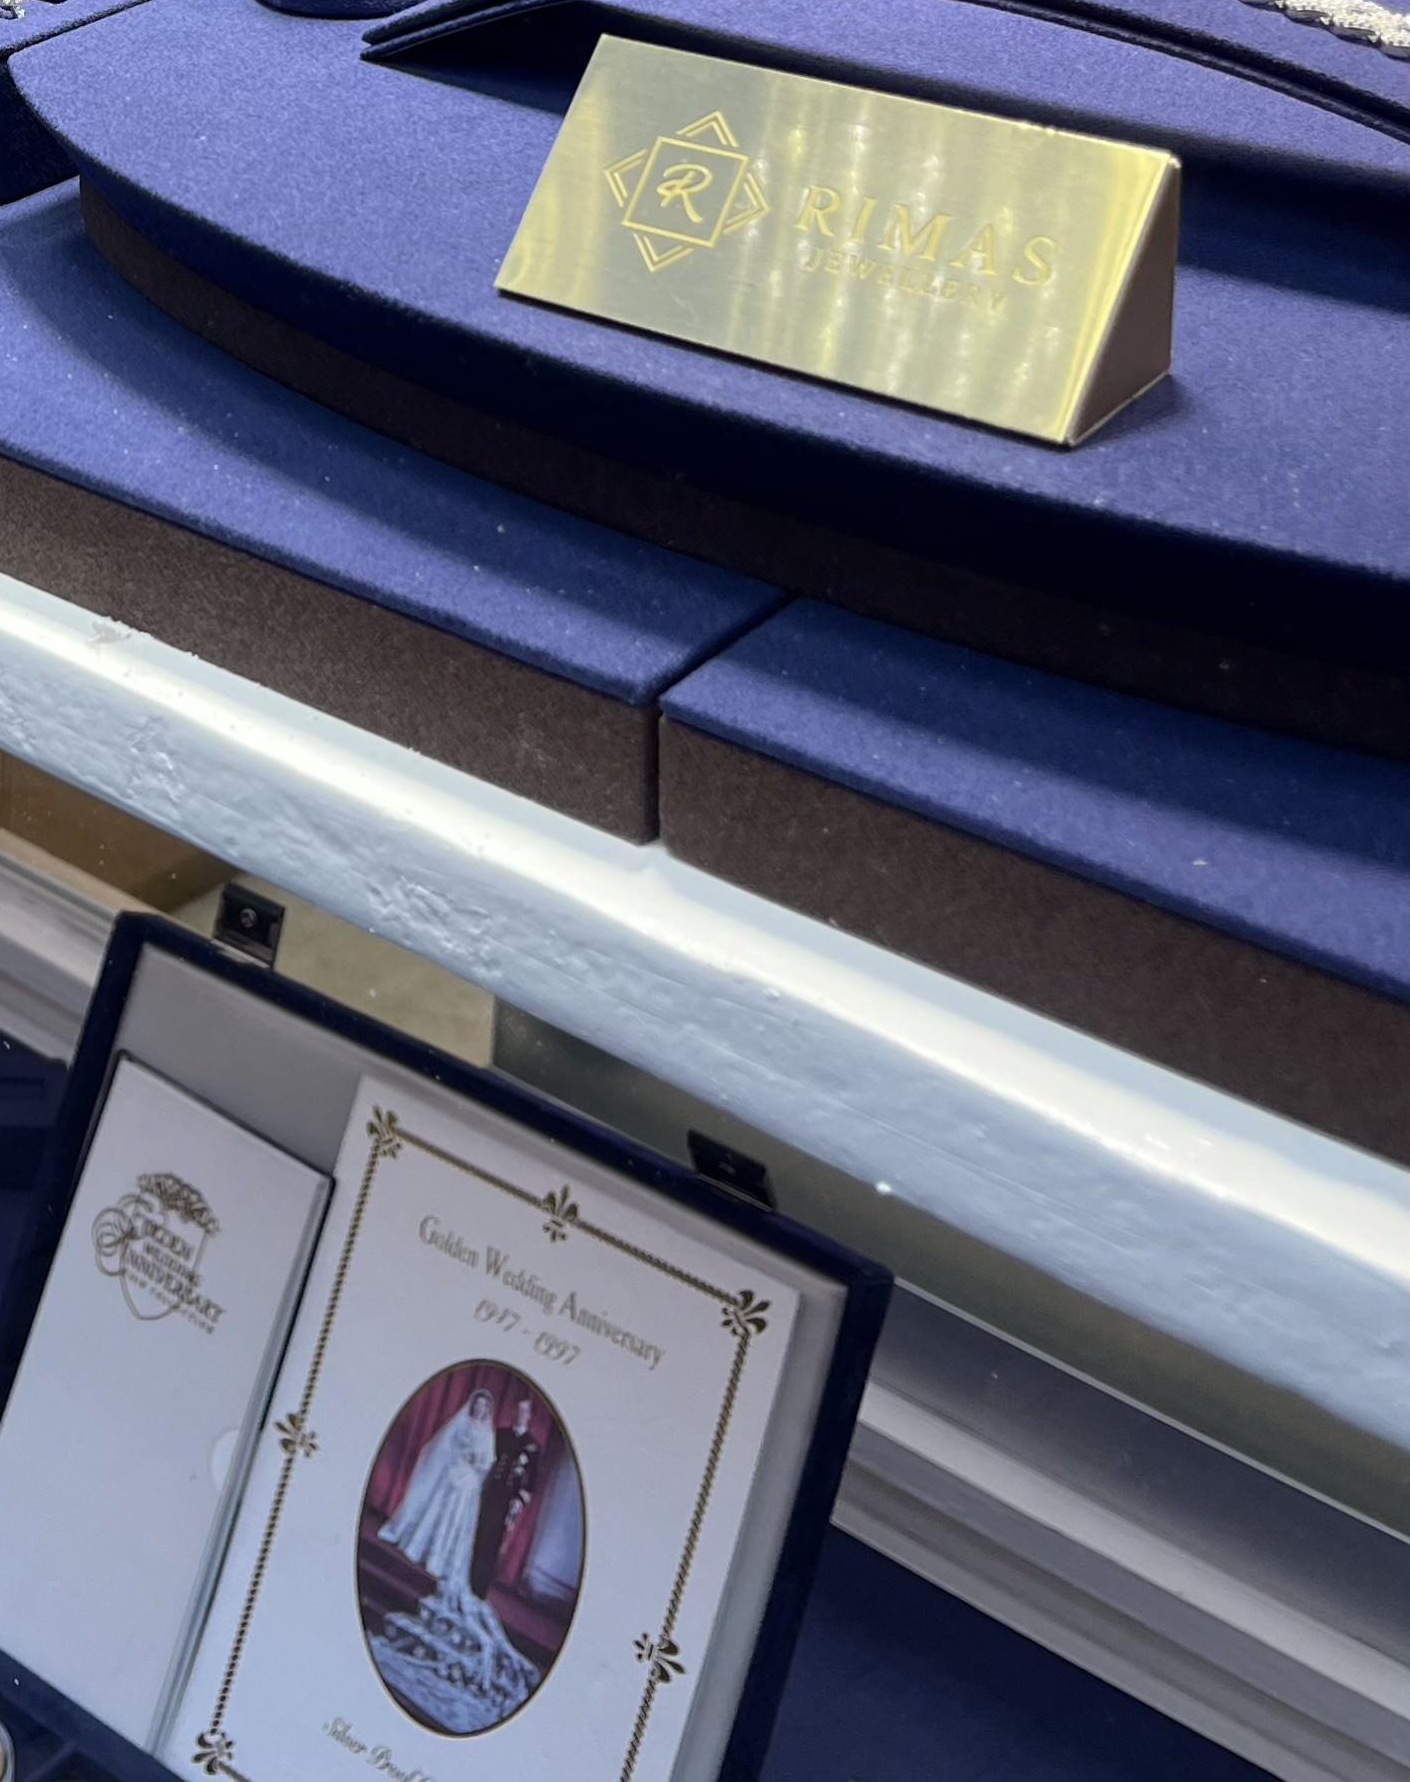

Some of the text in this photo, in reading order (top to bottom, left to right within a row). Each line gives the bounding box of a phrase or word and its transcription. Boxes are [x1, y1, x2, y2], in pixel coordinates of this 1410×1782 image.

[794, 184, 1057, 286] RIMAS
[804, 247, 1007, 310] JEWELLERY
[419, 1215, 666, 1370] Golden Wedding Anniversary
[534, 1331, 580, 1365] 1997
